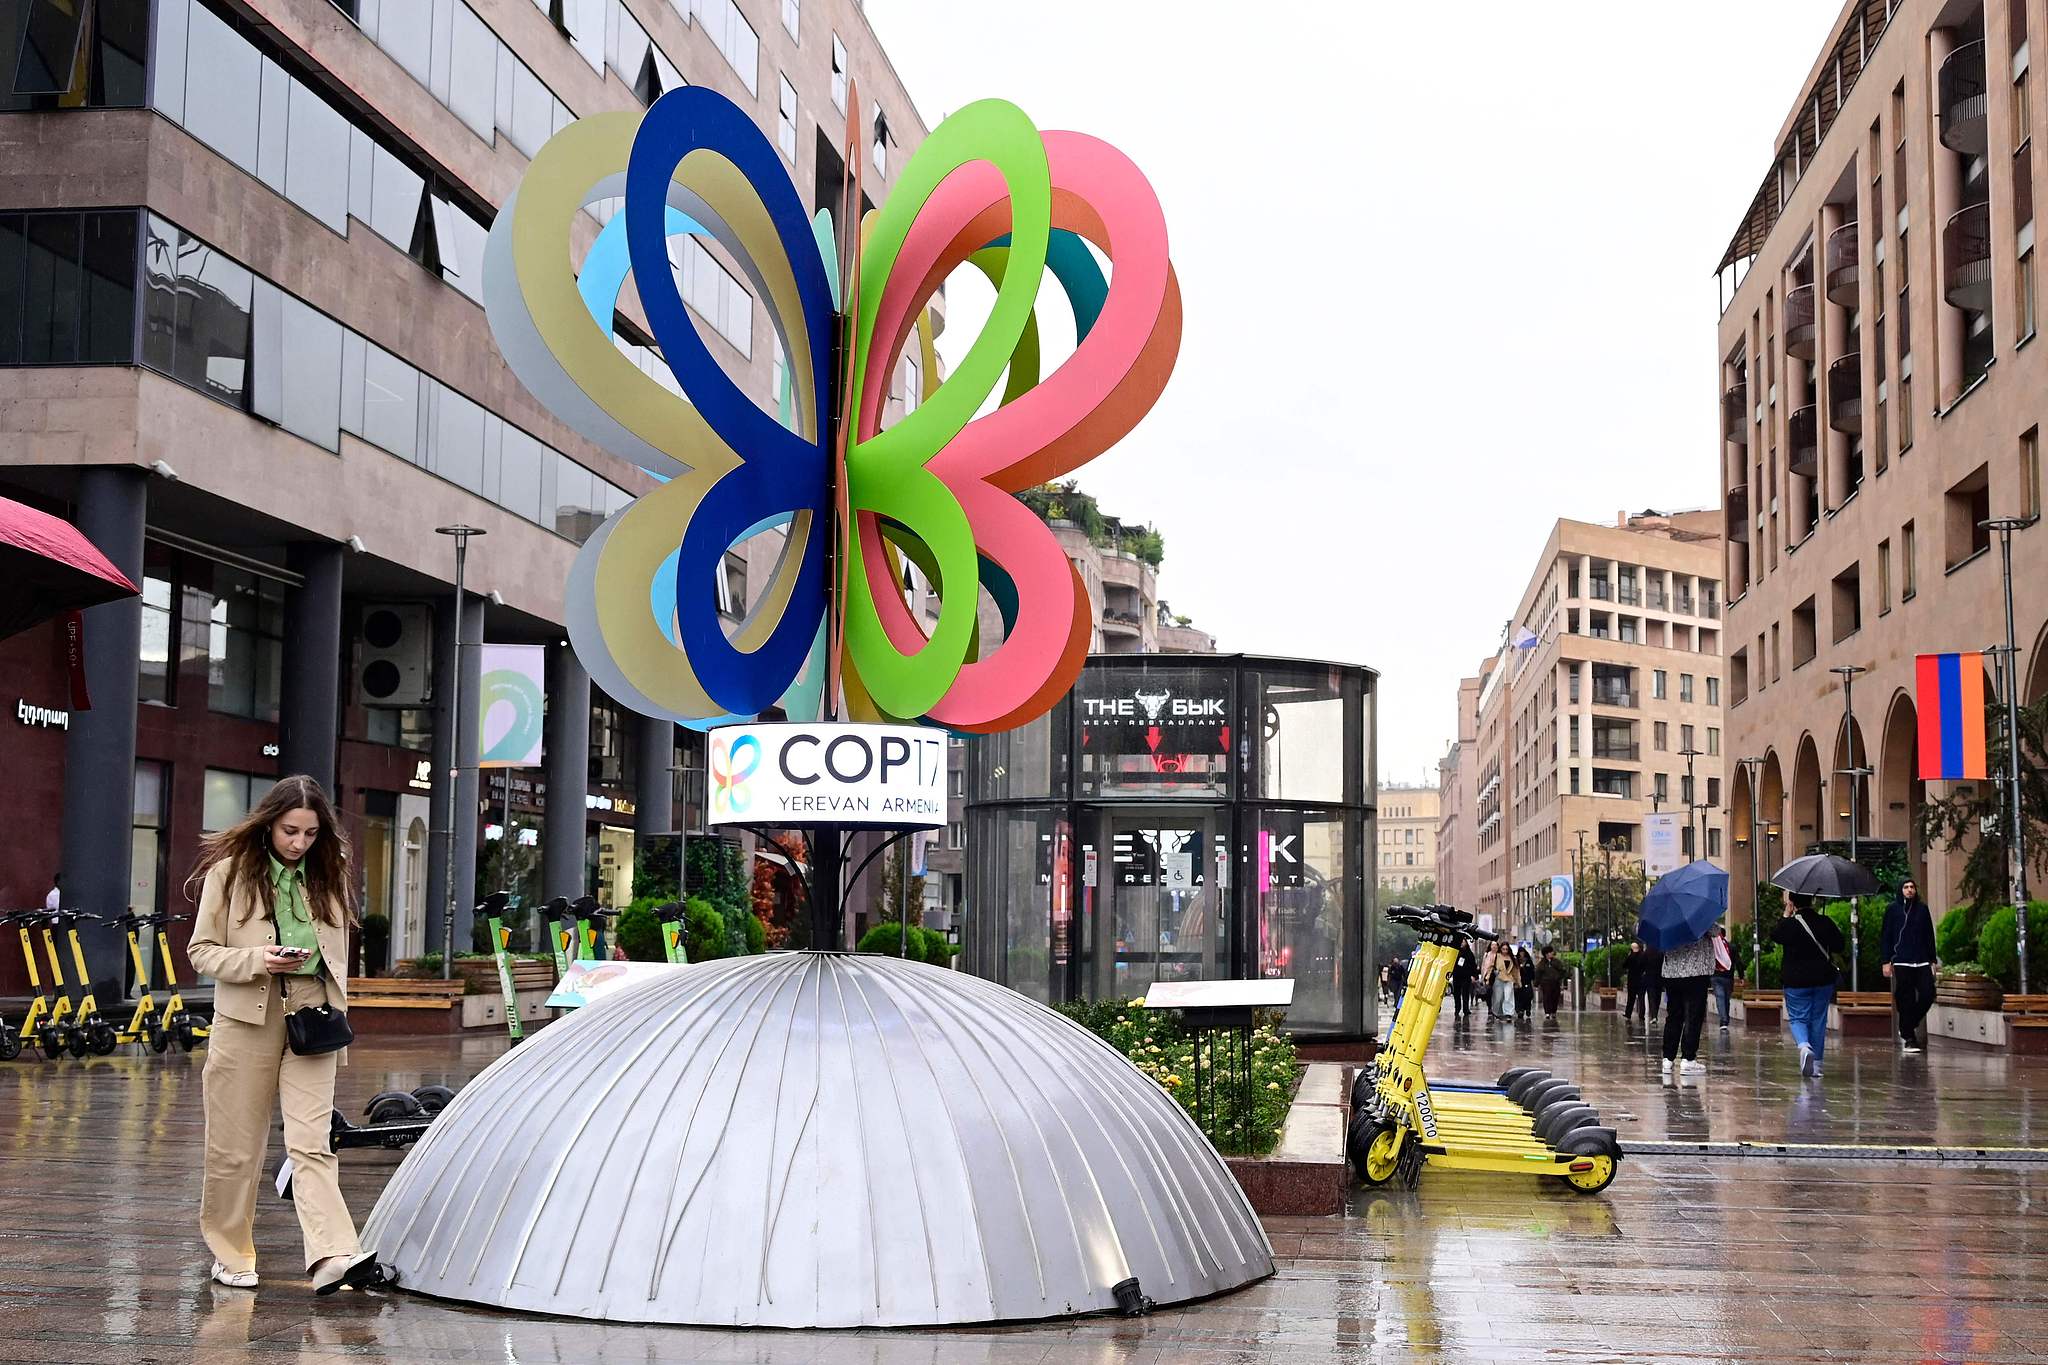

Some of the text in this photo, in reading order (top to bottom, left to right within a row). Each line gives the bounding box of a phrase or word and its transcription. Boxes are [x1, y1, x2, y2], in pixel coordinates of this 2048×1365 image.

[1083, 699, 1225, 716] THE БЫК
[778, 734, 940, 787] COP17
[779, 796, 869, 811] YEREVAN
[1416, 1092, 1437, 1138] 120010
